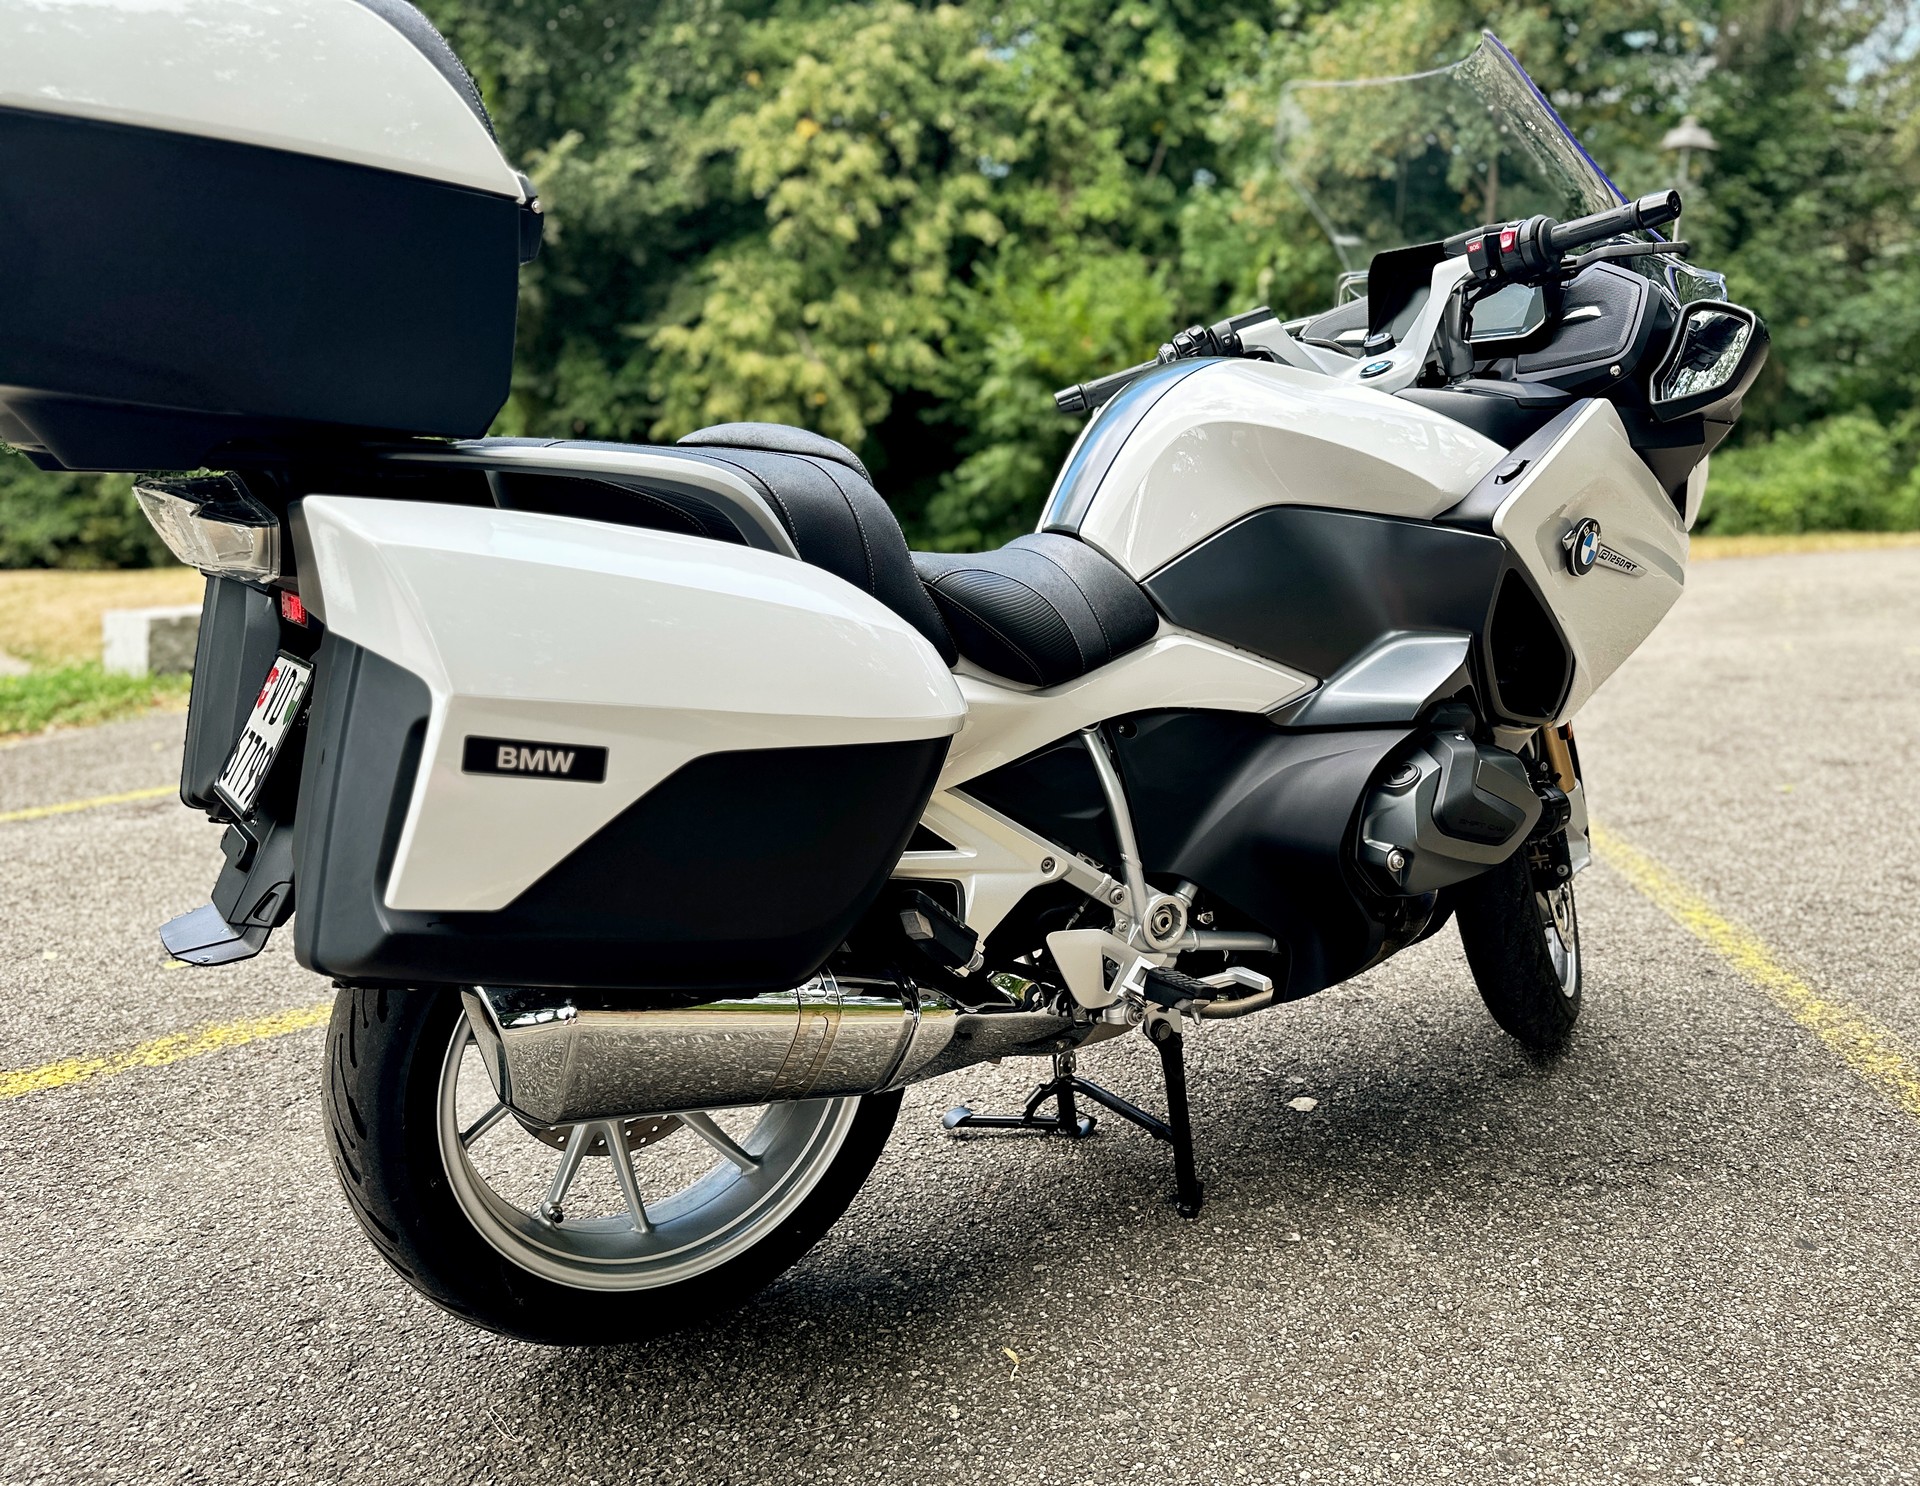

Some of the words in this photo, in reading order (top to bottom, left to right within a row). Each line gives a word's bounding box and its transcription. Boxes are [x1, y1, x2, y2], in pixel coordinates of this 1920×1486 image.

[1469, 244, 1480, 252] SOS
[263, 664, 297, 725] VD
[222, 727, 274, 804] 67799
[497, 746, 575, 773] BMW
